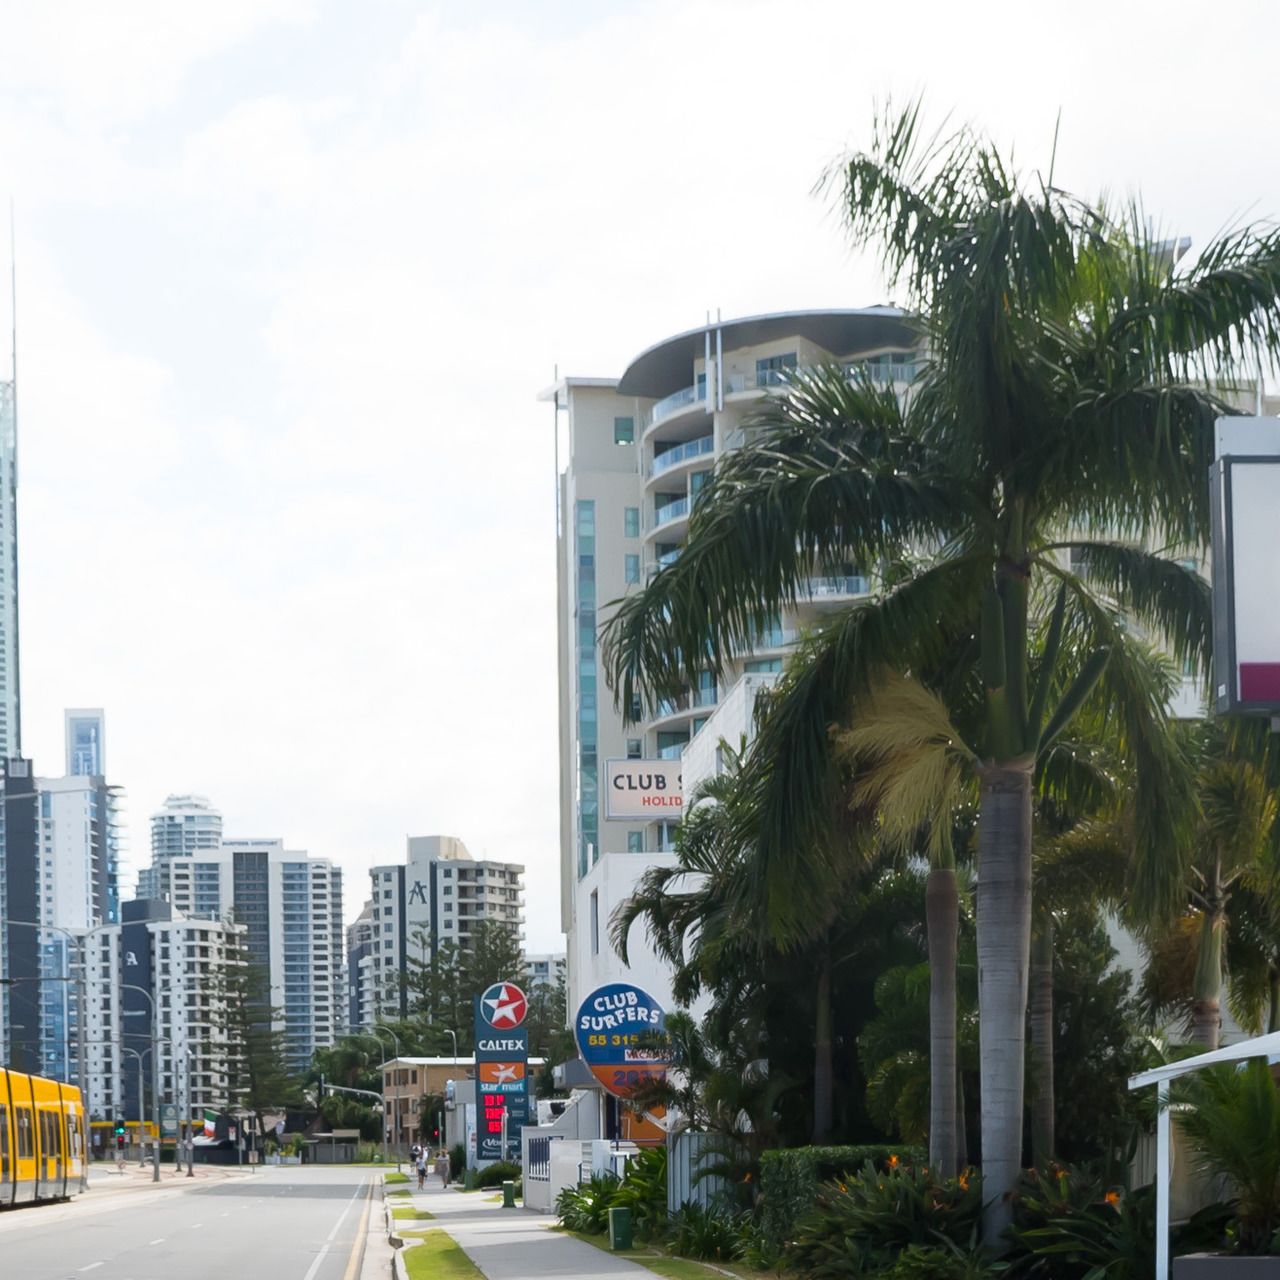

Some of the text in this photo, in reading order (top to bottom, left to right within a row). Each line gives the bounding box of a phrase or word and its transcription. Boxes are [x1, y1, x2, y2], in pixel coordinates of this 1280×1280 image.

[612, 773, 667, 791] CLUB
[593, 990, 639, 1012] CLUB
[580, 1006, 661, 1031] SURFERS
[478, 1039, 525, 1051] CALTEX
[480, 1082, 525, 1092] star mart
